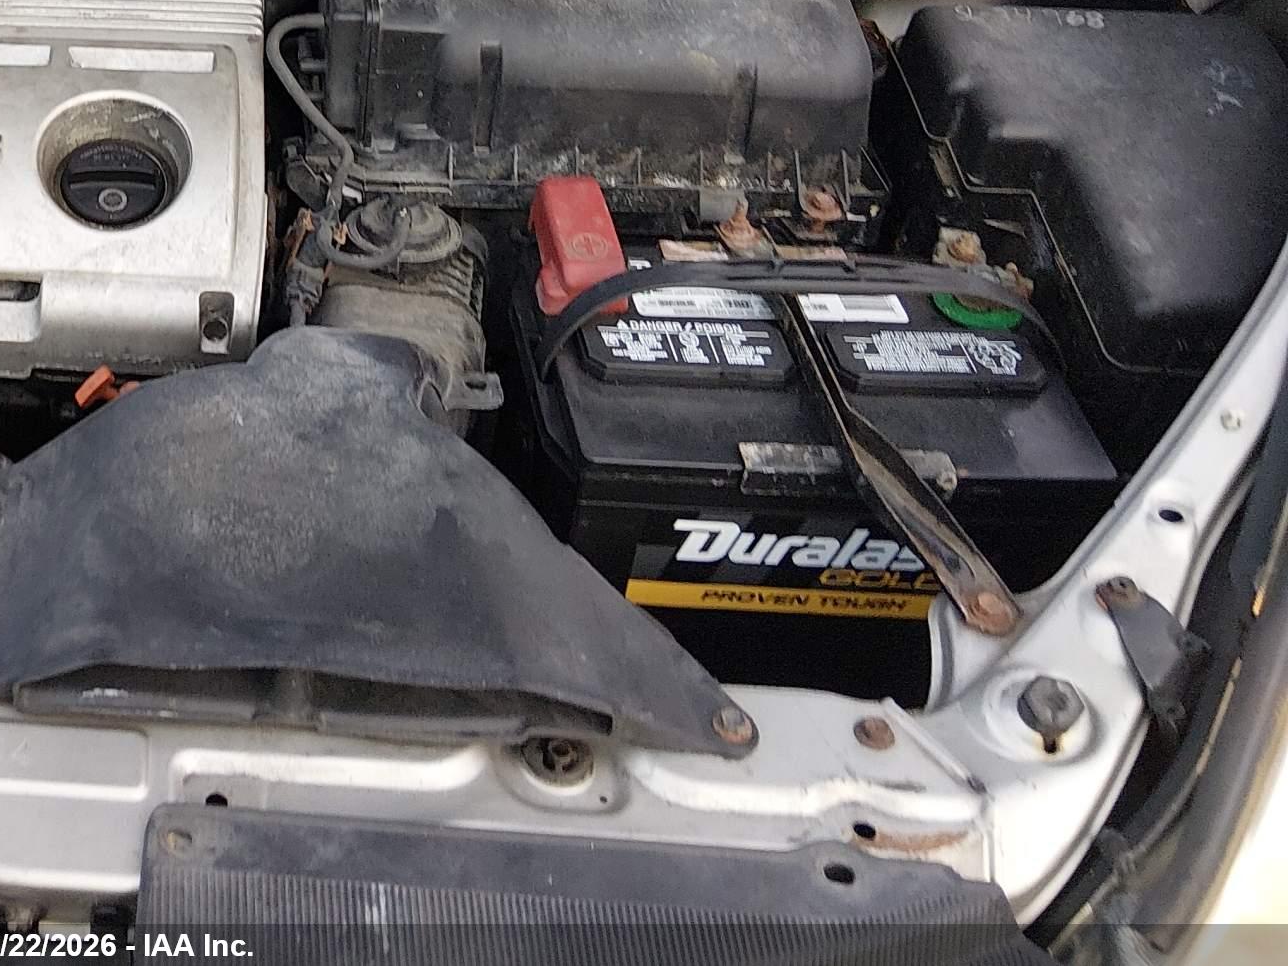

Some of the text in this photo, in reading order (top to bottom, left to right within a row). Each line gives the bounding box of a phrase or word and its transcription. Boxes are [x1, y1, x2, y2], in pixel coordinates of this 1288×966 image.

[629, 319, 743, 334] DANGER POISON
[673, 518, 926, 571] Duralas
[701, 589, 907, 611] PROVEN TOUGH
